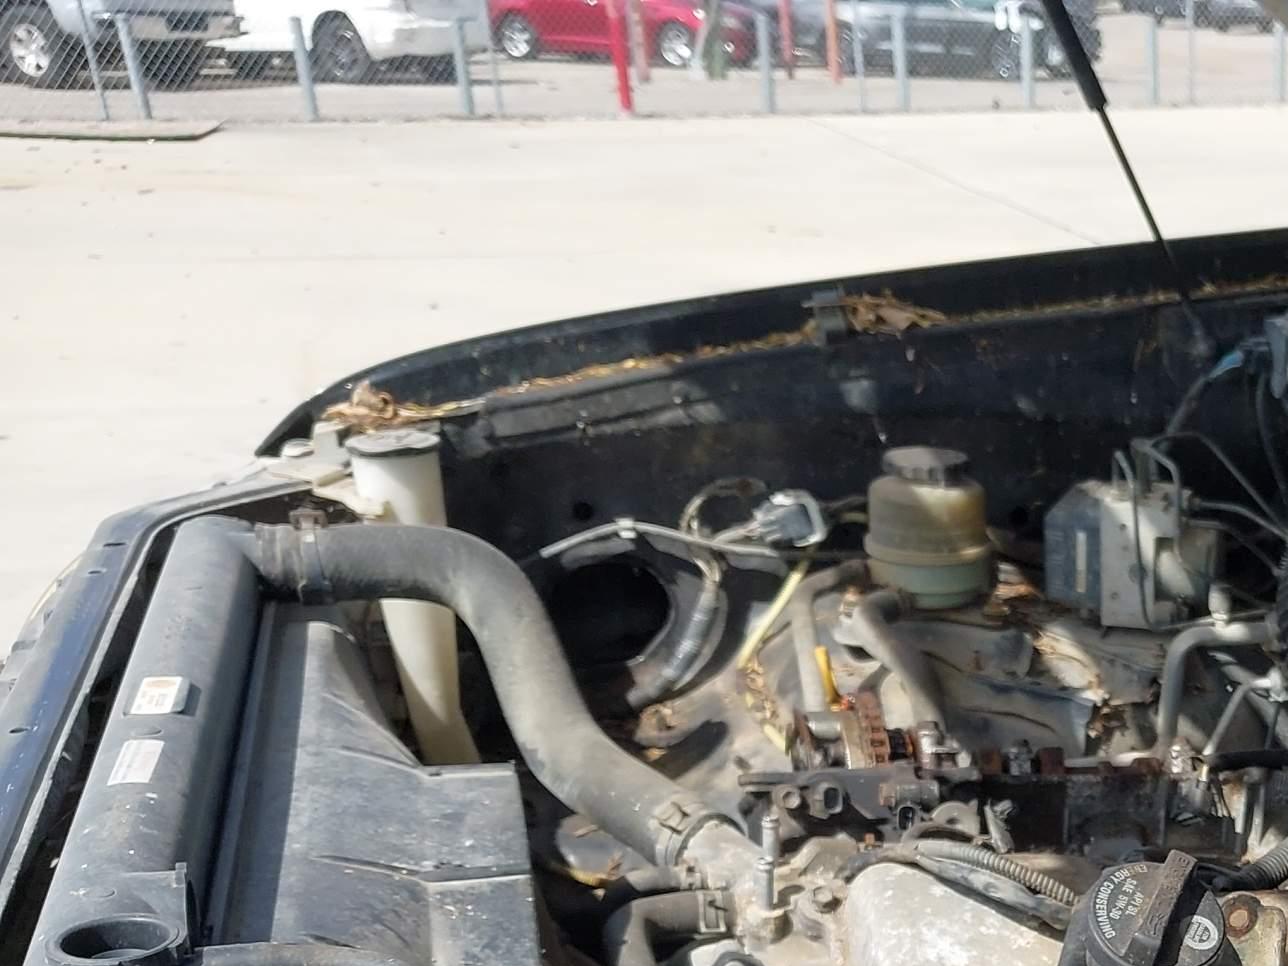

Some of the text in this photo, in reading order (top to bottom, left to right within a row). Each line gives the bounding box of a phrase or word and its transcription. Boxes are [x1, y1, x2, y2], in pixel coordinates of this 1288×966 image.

[1095, 864, 1148, 940] ENERGY CONSERVING
[1109, 878, 1137, 920] SAE 5W-30
[1130, 891, 1144, 907] API
